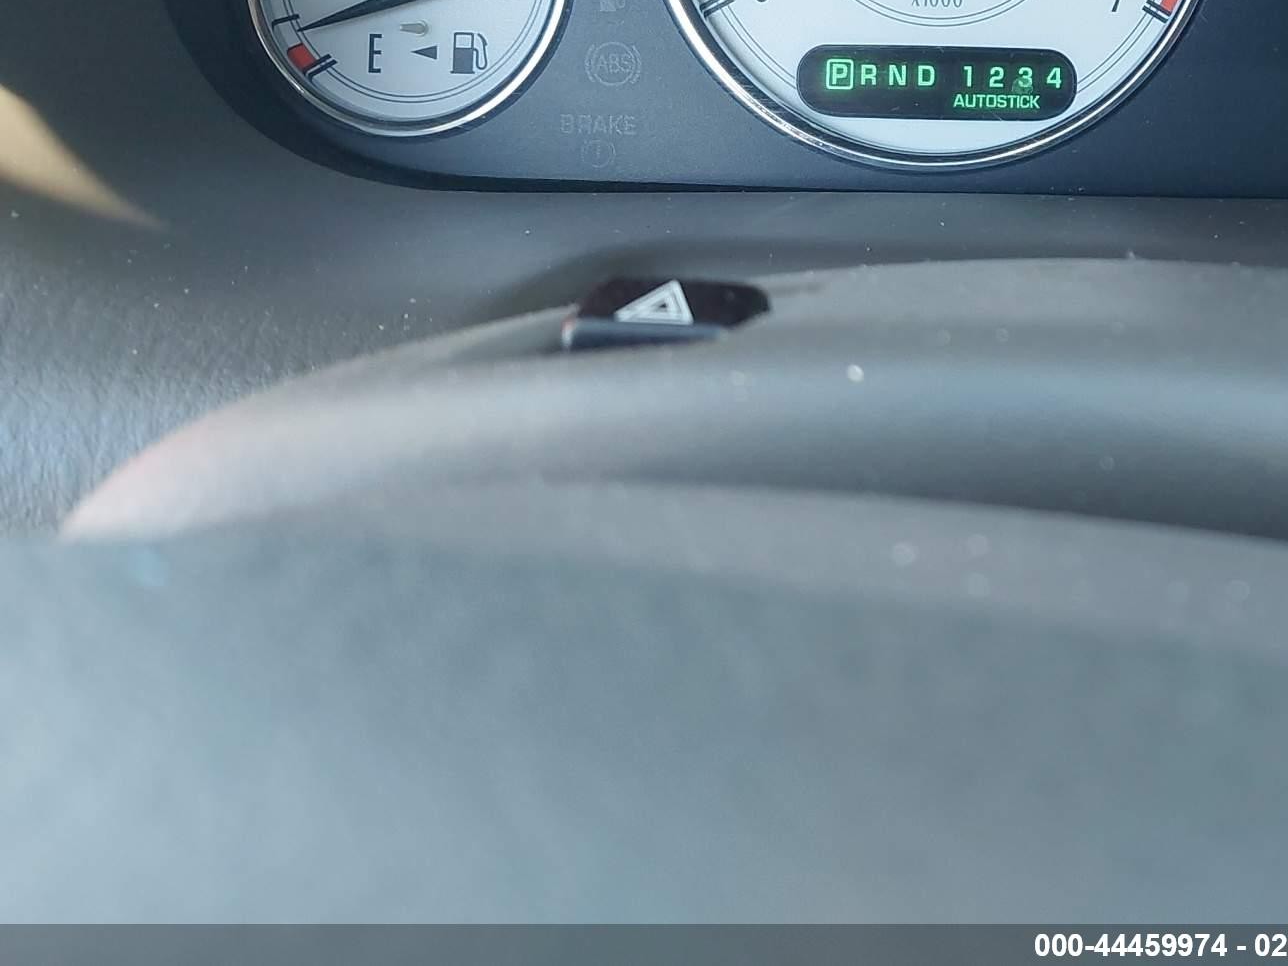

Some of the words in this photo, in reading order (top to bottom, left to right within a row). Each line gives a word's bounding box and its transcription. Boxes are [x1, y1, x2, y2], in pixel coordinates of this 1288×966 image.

[368, 33, 382, 73] E
[953, 94, 1040, 109] AUTOSTICK
[560, 114, 636, 134] BRAKE
